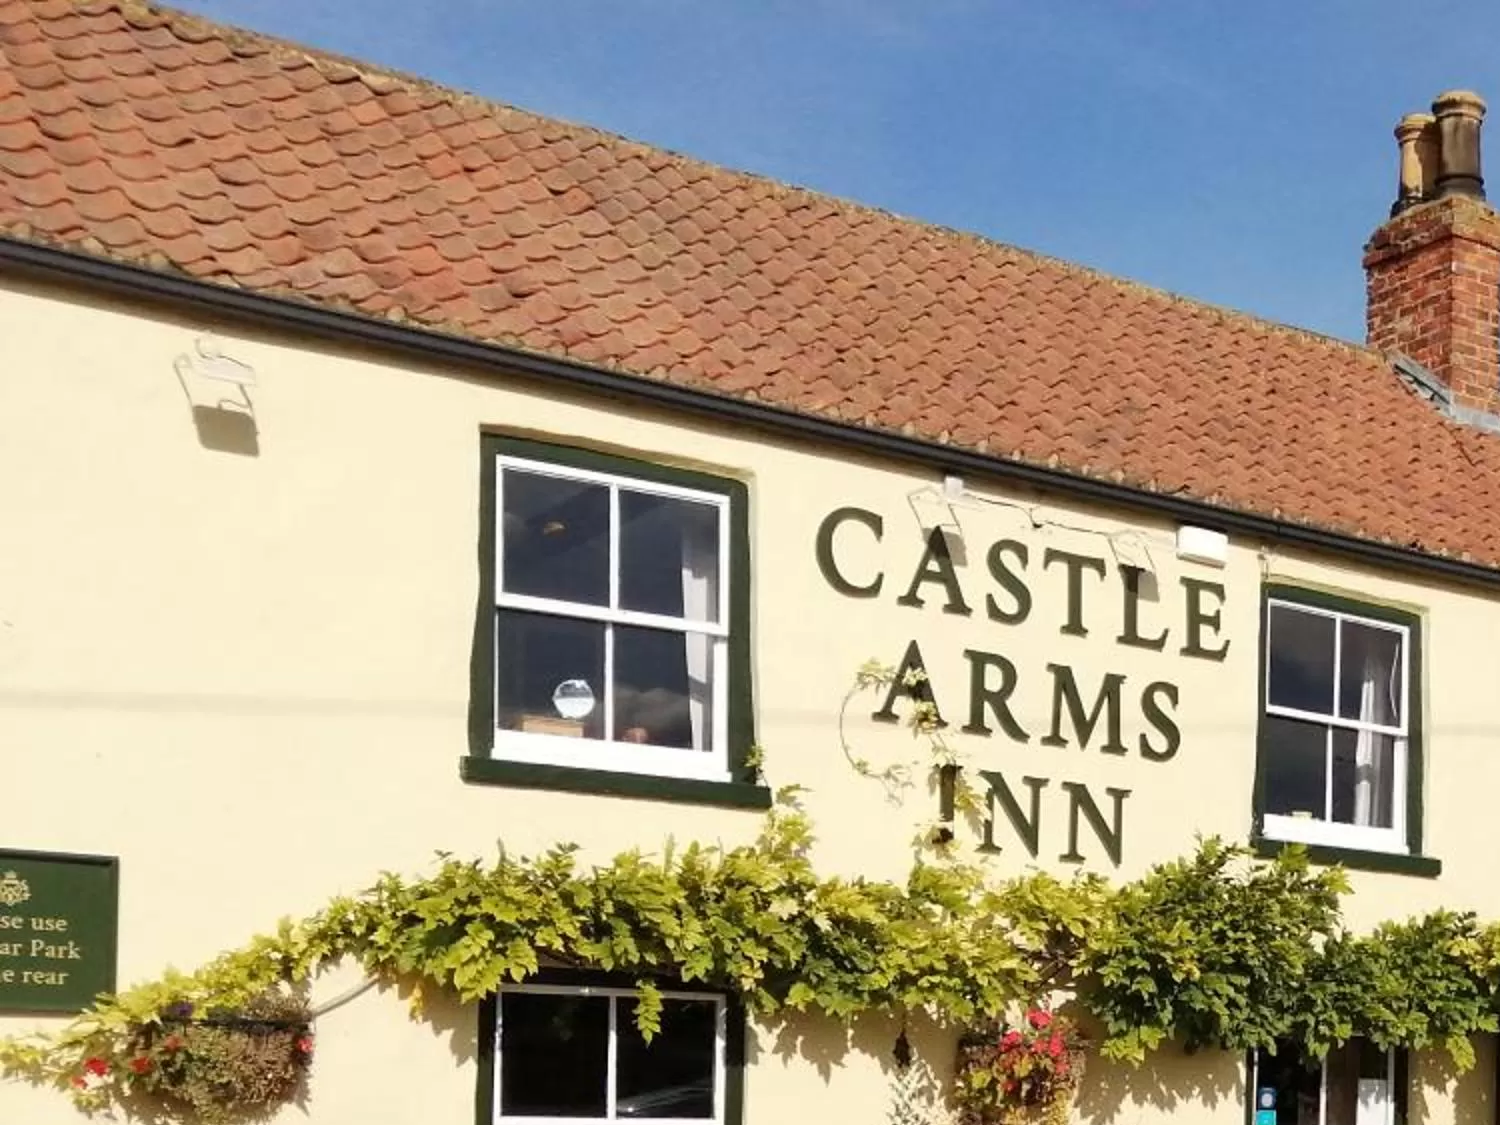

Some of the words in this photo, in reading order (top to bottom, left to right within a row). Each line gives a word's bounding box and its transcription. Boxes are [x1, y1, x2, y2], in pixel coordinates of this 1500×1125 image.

[815, 505, 1231, 662] CASTLE
[871, 639, 1181, 763] ARMS
[932, 764, 1132, 868] INN
[0, 943, 23, 956] ar
[30, 939, 81, 959] Park
[30, 917, 68, 931] use
[22, 971, 70, 985] rear
